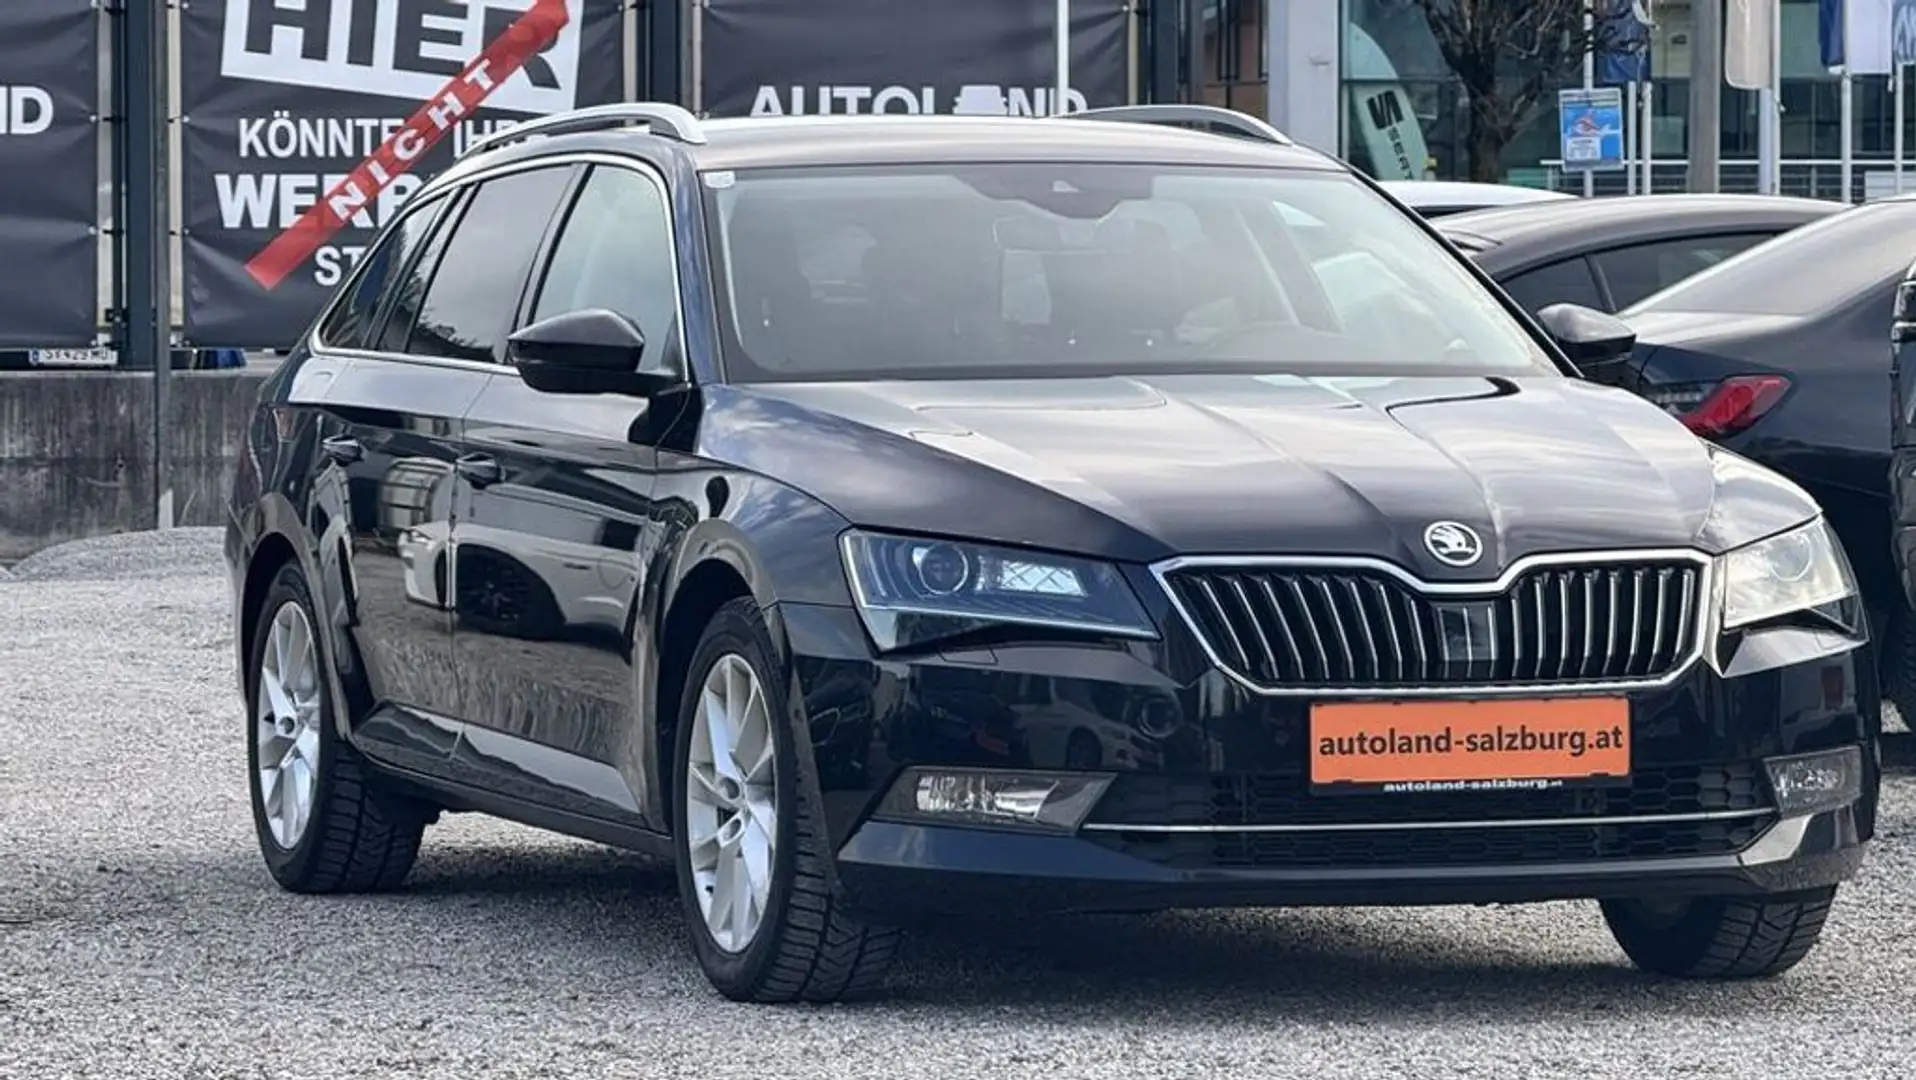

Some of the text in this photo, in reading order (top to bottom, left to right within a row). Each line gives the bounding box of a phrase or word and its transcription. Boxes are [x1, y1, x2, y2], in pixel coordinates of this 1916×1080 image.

[0, 86, 54, 135] D
[327, 57, 495, 222] NICHT
[1319, 725, 1623, 757] autoland-salzburg.at
[1383, 778, 1563, 792] autoland-salzburg.at
